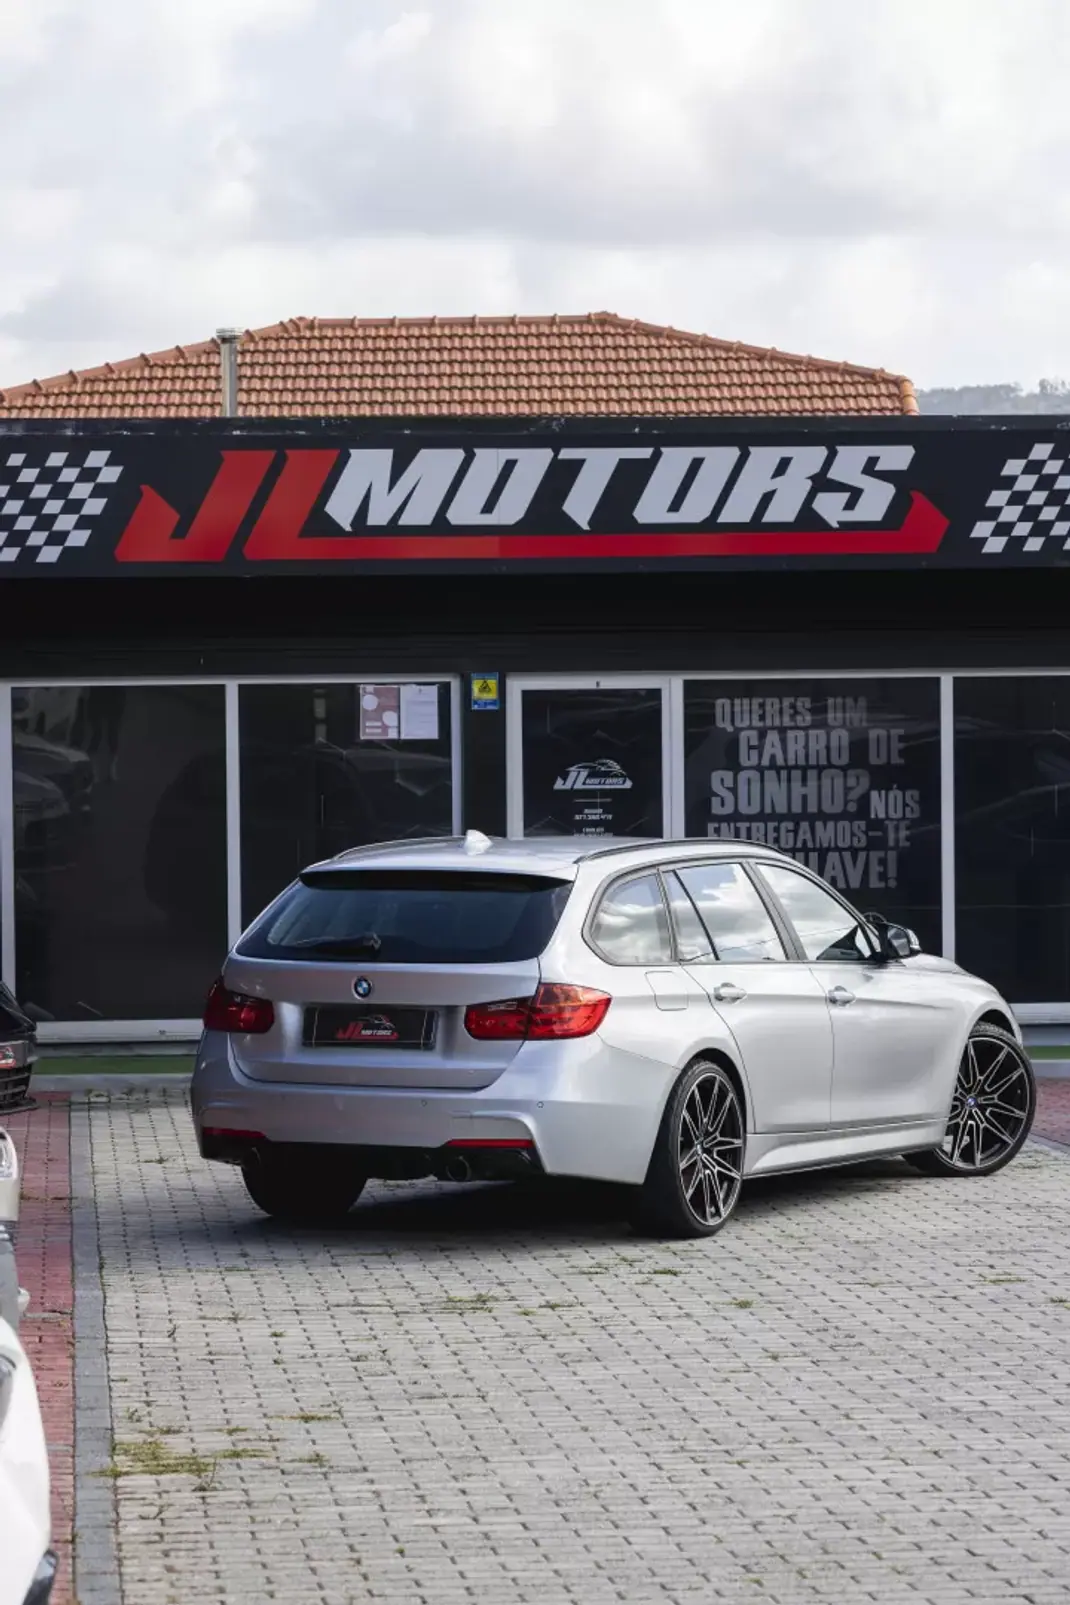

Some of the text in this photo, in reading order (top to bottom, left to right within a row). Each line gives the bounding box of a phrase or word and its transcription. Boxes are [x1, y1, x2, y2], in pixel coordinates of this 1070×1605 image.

[114, 445, 916, 562] JL MOTORS
[715, 697, 868, 732] QUERES UM
[738, 728, 905, 767] CARRO DE
[710, 768, 921, 820] SONHO? NÓS
[782, 851, 898, 889] AVE!
